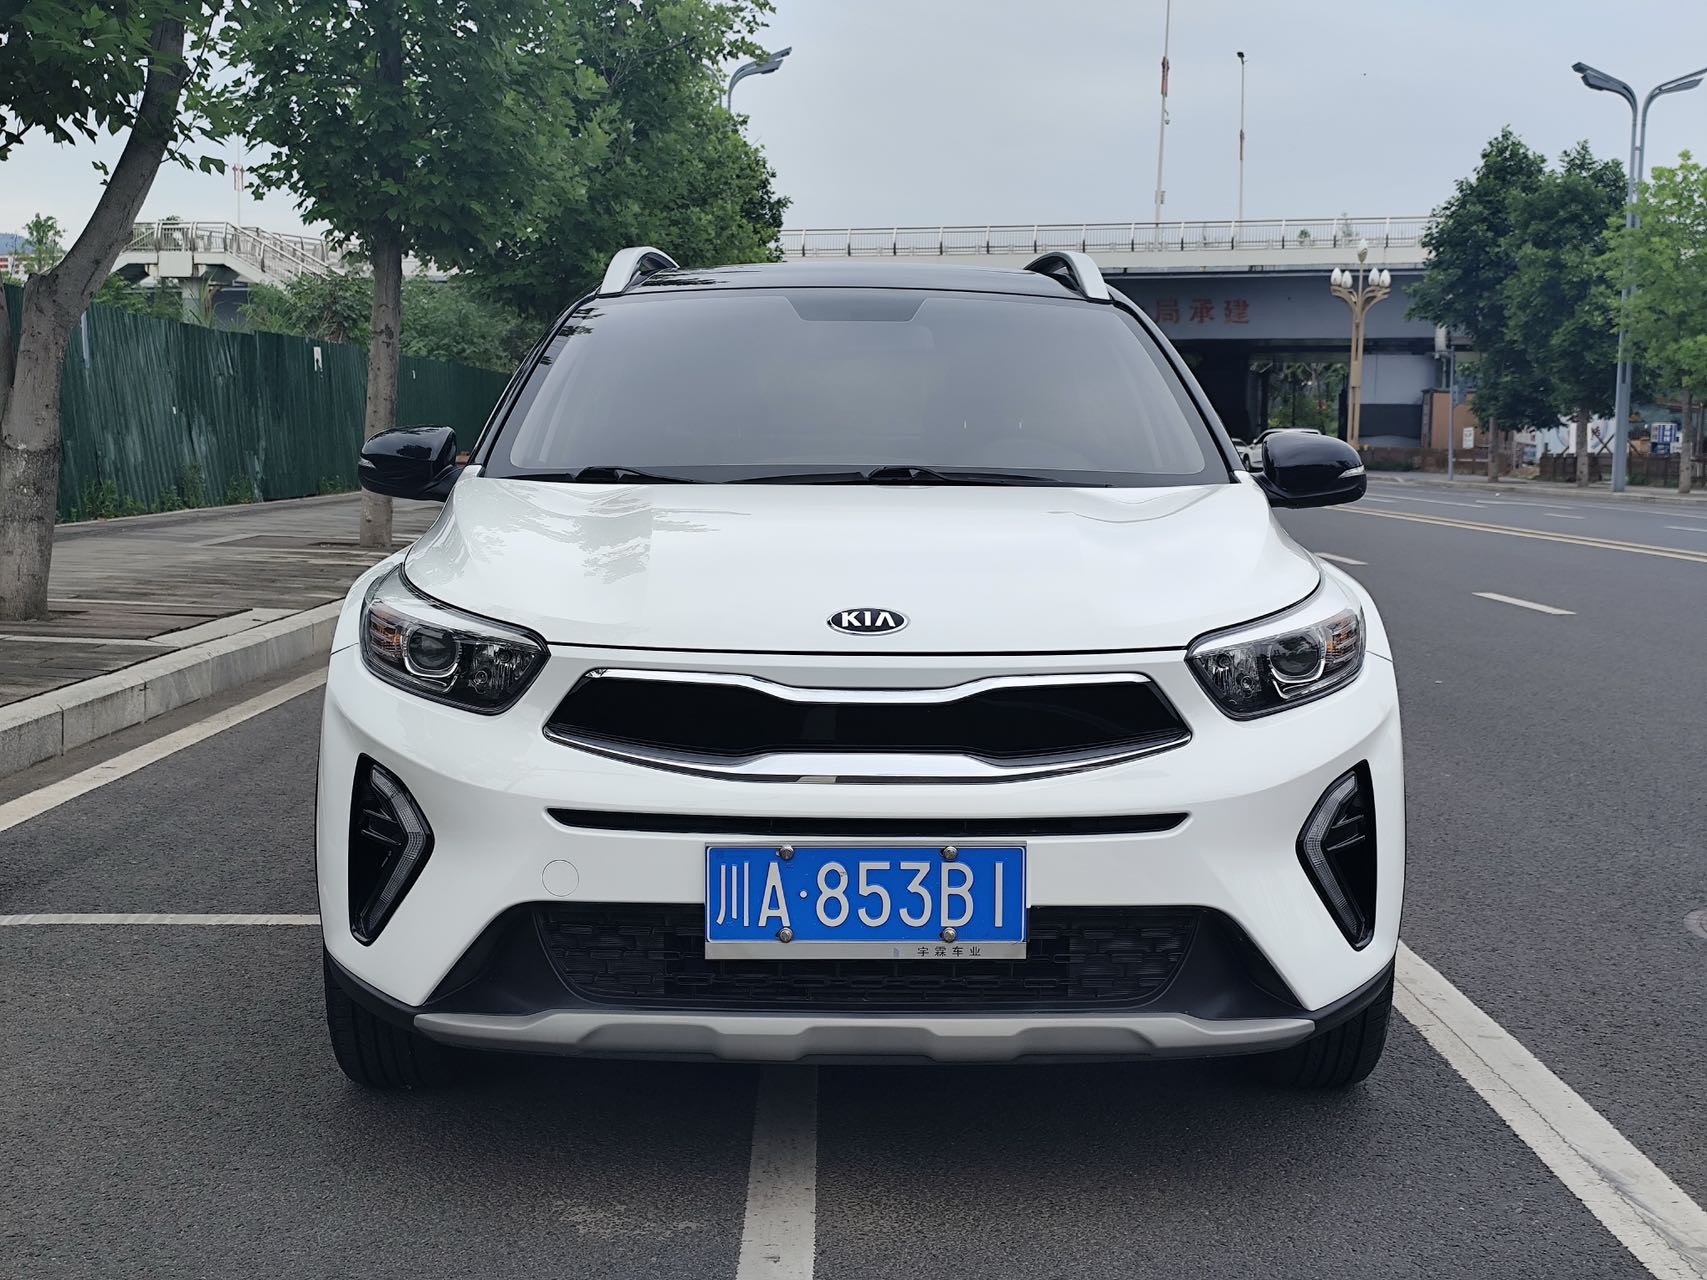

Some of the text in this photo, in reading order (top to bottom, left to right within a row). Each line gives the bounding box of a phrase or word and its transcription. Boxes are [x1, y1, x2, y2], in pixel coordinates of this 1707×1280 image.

[841, 611, 896, 627] KIA
[716, 862, 1003, 928] 川A·853B1
[916, 945, 981, 957] 宇霖车业
